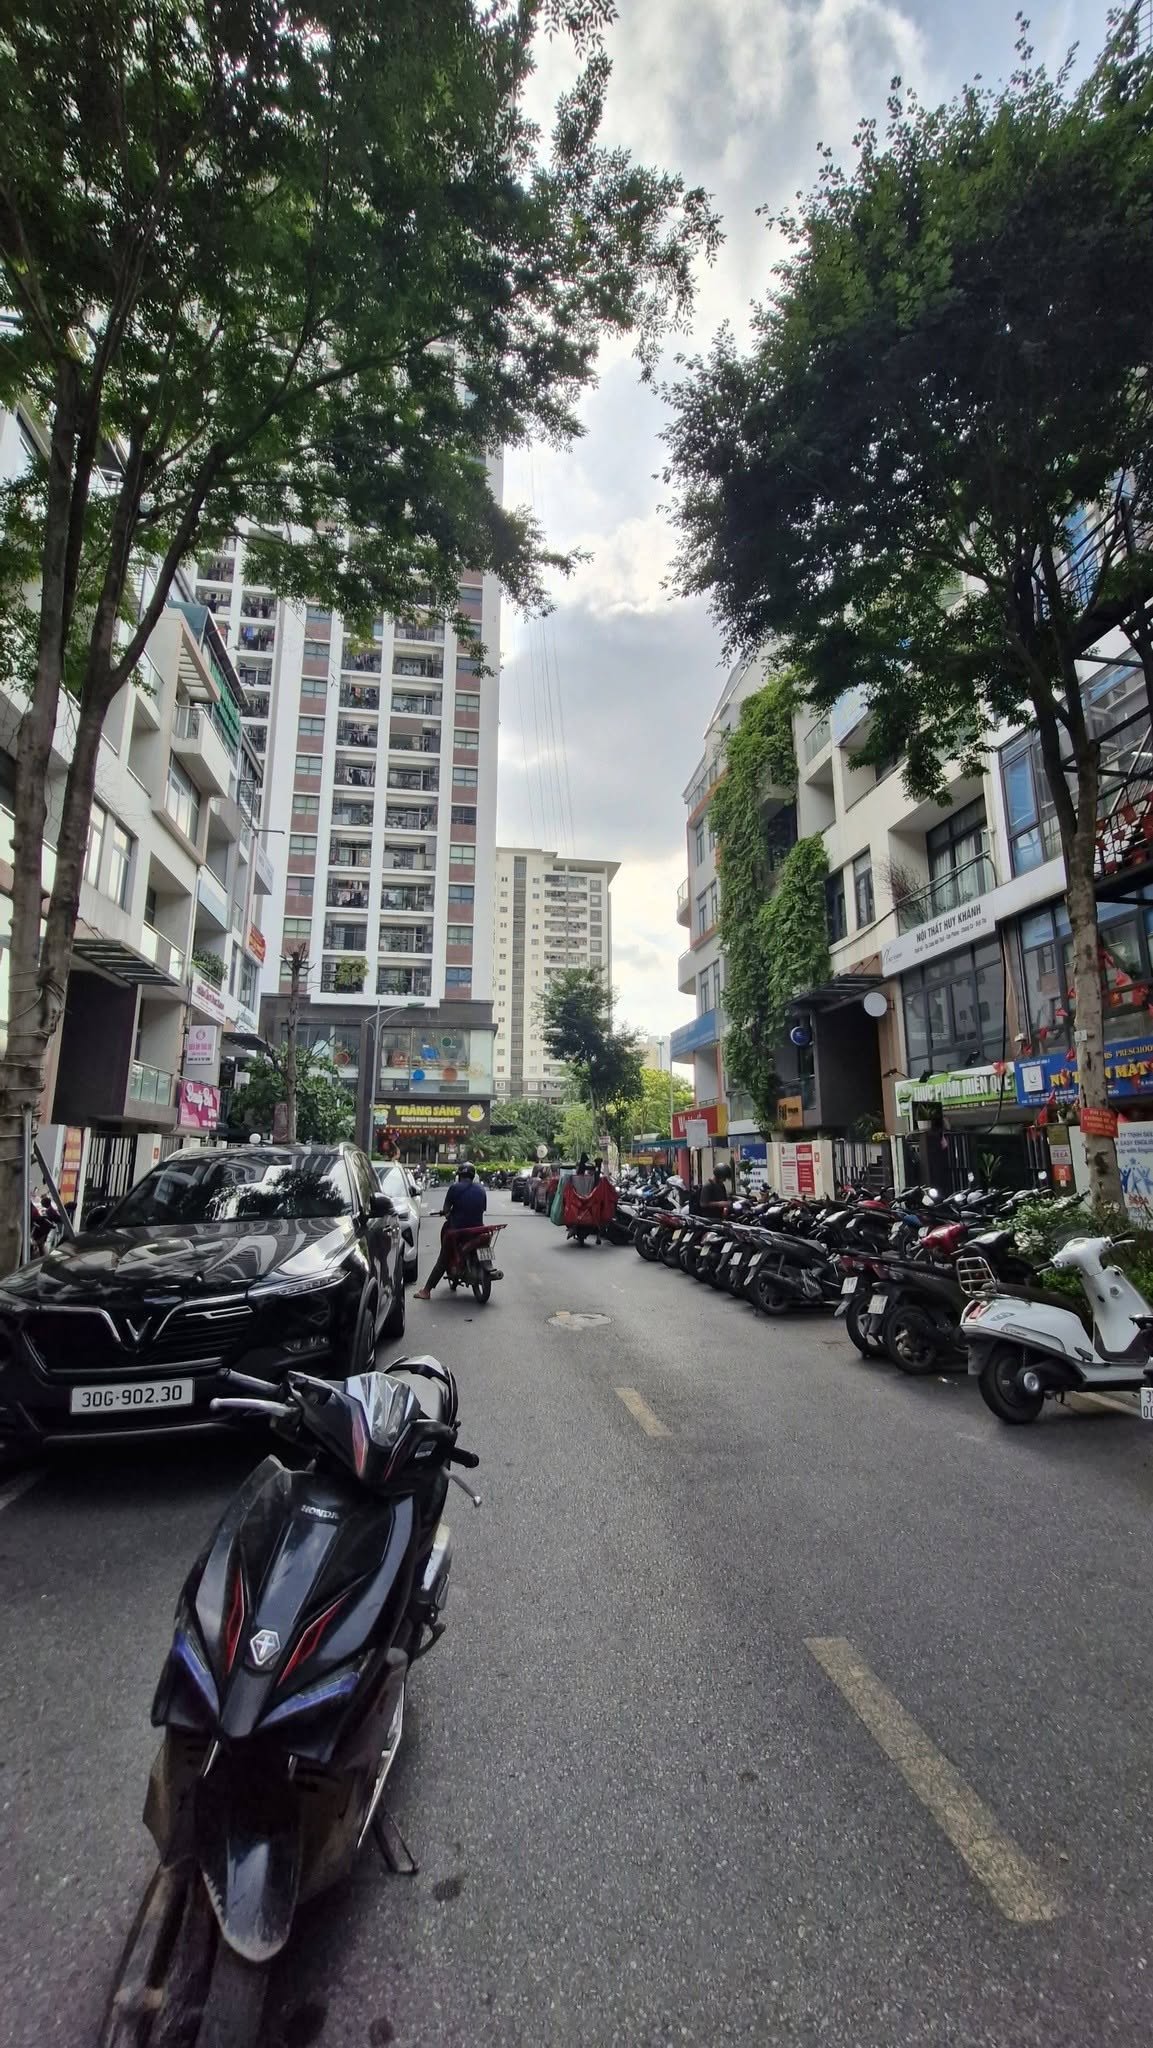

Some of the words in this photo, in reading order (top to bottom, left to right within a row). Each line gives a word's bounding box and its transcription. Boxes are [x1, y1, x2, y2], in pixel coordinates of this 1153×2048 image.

[943, 916, 956, 931] HUY
[957, 904, 982, 922] KHÁNH
[1115, 1044, 1153, 1057] PRESCHOO
[394, 1104, 432, 1116] TRĂNG
[432, 1104, 462, 1117] SÁNG
[301, 1504, 340, 1520] HONDA
